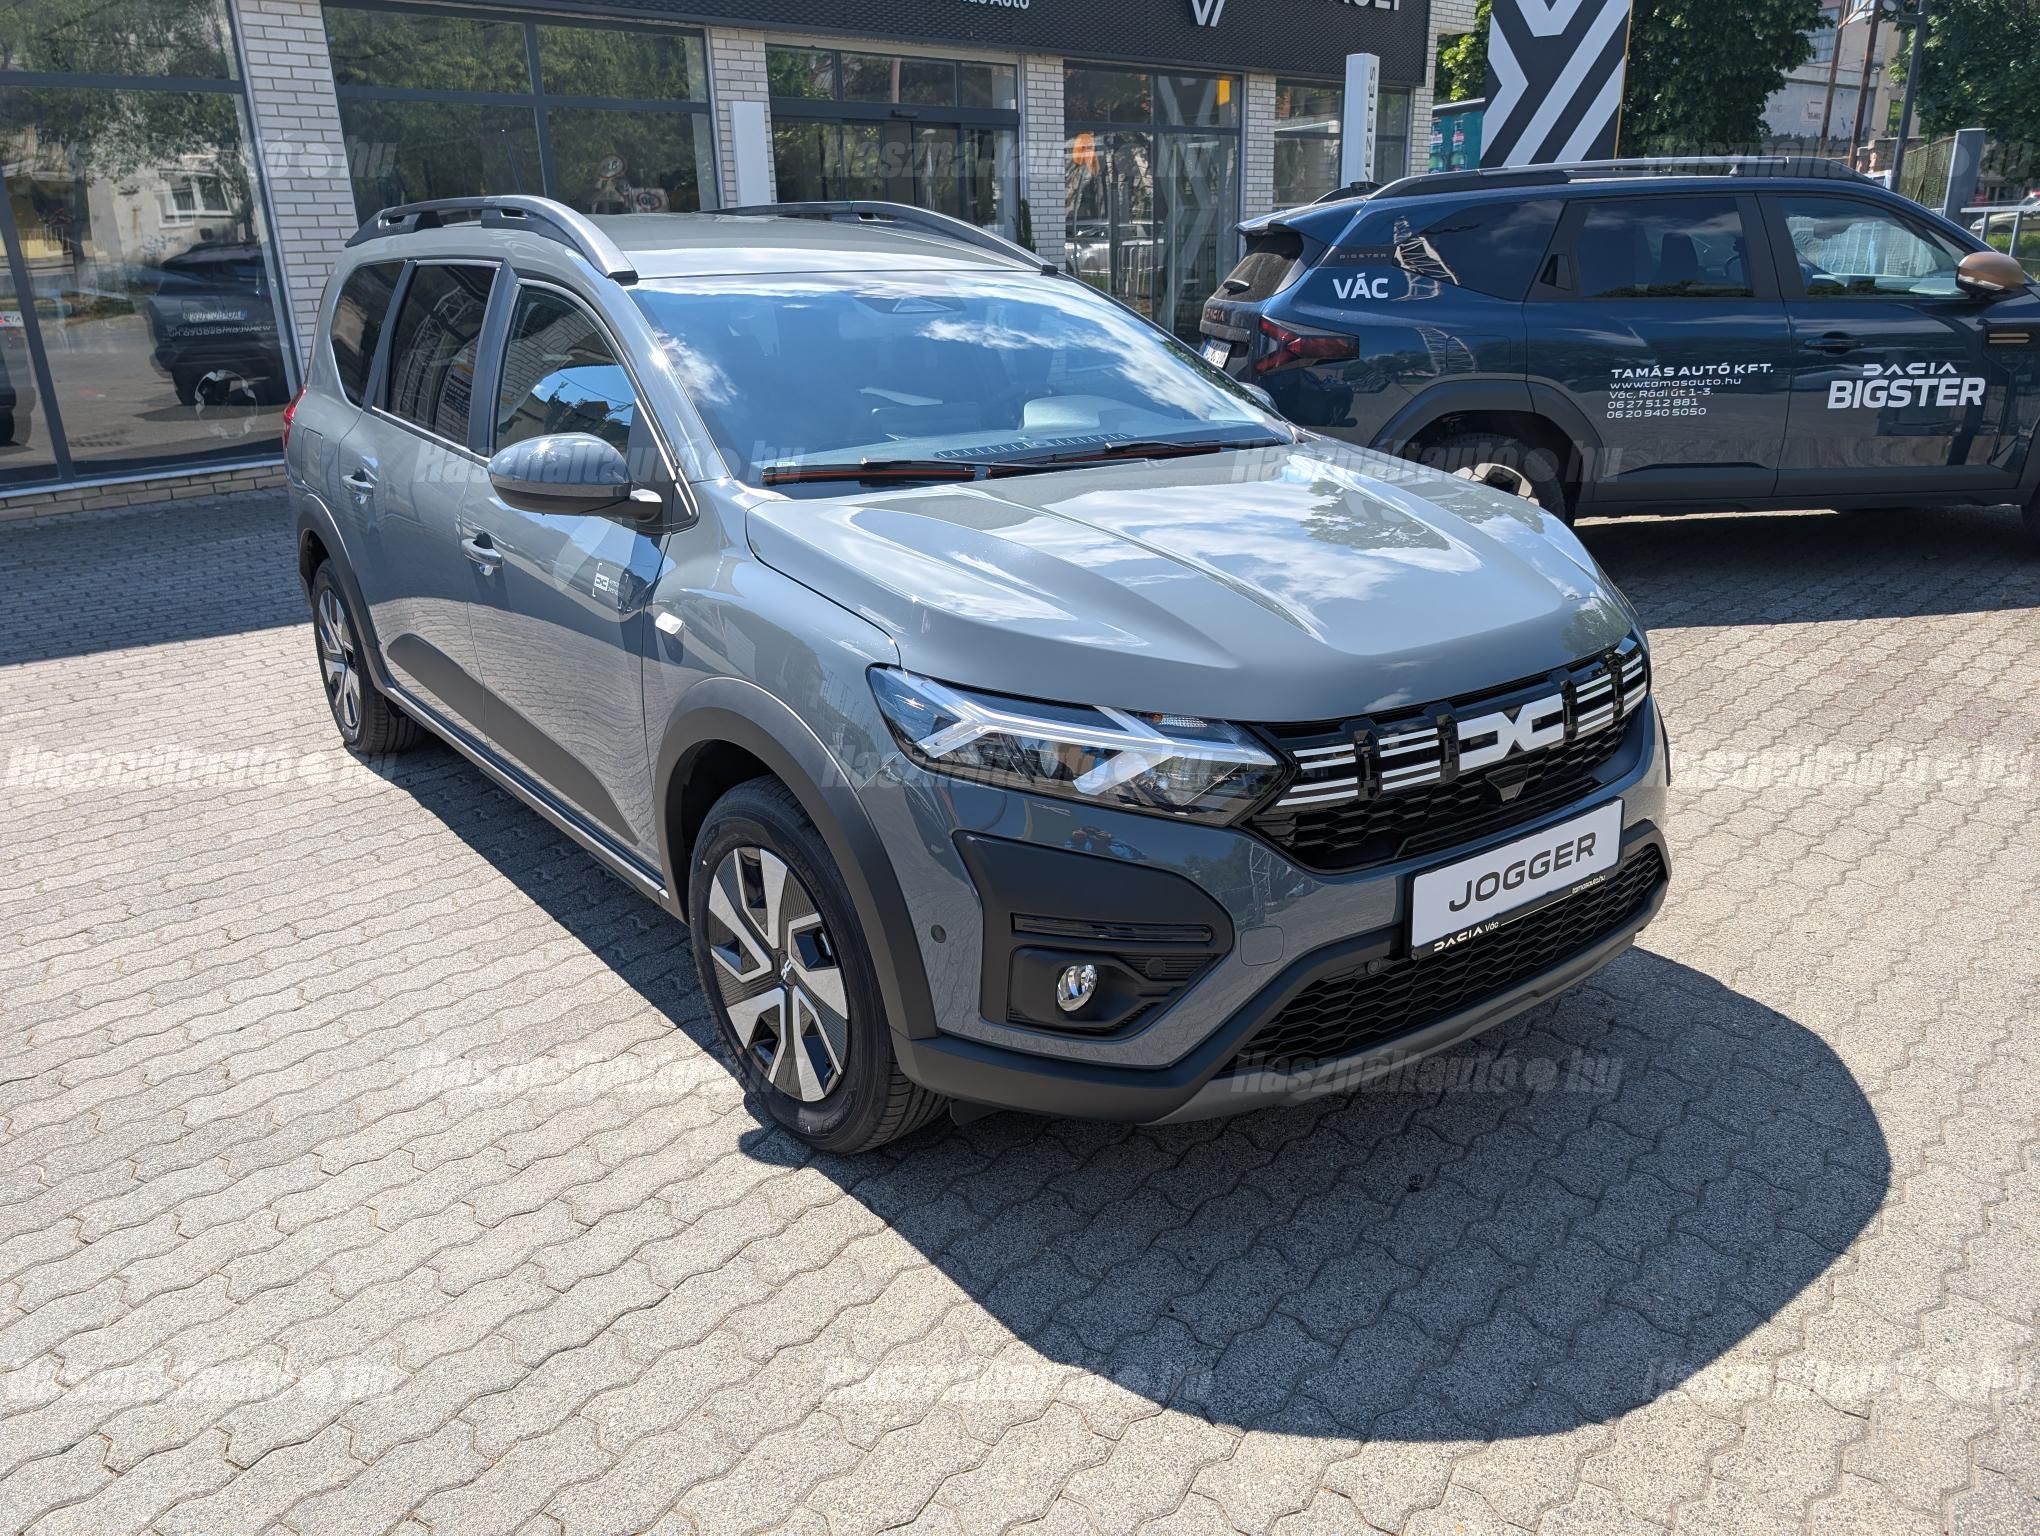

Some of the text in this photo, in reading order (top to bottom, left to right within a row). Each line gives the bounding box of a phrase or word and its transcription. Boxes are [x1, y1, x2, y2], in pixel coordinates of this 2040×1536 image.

[1332, 272, 1389, 300] VÁC
[1610, 362, 1774, 379] TAMÁS AUTÓ KFT.
[1862, 362, 1958, 377] DACIA
[1610, 377, 1742, 389] www.tamasauto.hu
[1609, 390, 1637, 399] Vác,
[1638, 389, 1668, 399] Rádi
[1688, 387, 1715, 397] 1-3.
[1827, 377, 1986, 409] BIGSTER
[1607, 398, 1699, 409] 06 27 512 881
[1606, 407, 1707, 419] 06 20 940 5050
[1449, 832, 1596, 912] JOGGER
[1433, 926, 1483, 952] DACIA
